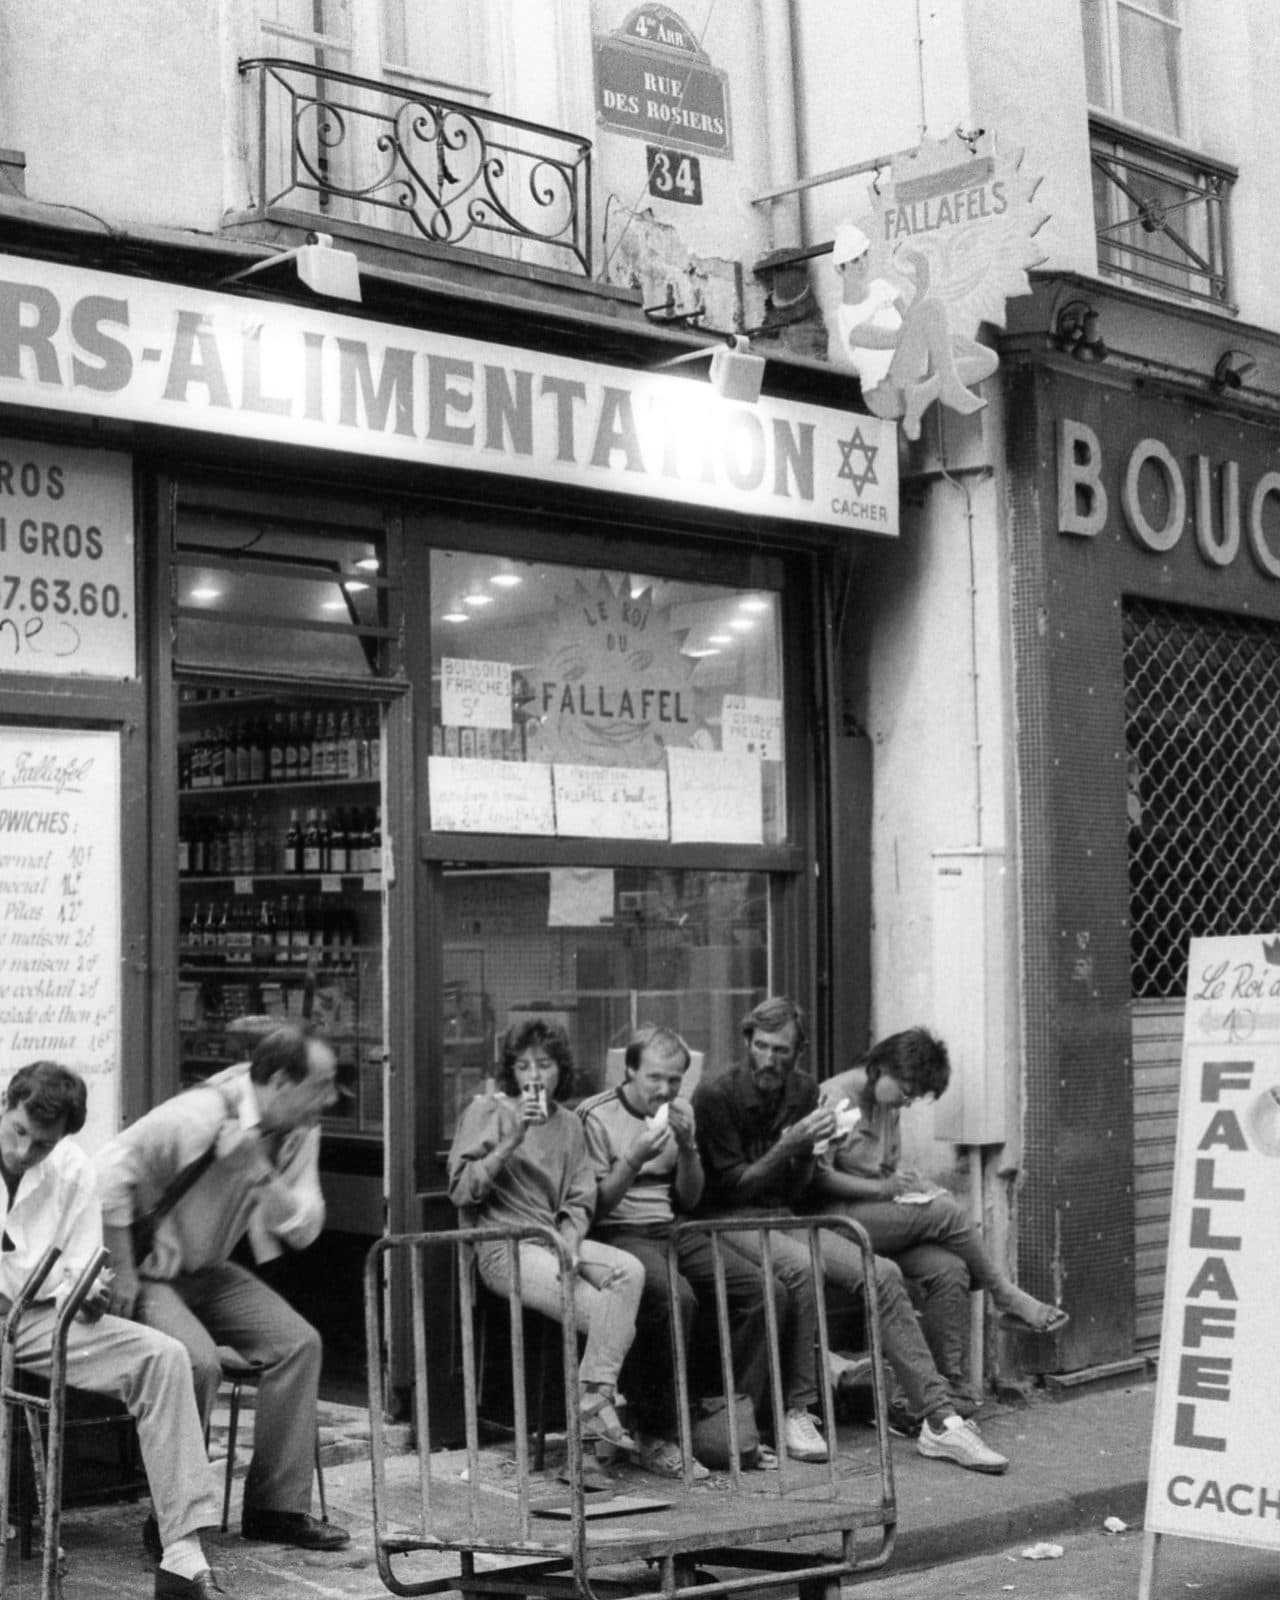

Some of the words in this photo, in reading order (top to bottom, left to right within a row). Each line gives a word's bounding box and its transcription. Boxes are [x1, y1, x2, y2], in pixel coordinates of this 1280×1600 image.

[644, 72, 683, 98] RUE
[603, 89, 640, 114] DES
[647, 100, 724, 135] ROSIERS
[655, 153, 695, 197] 34
[884, 181, 1008, 240] FALLAFELS
[831, 497, 888, 523] CACHER
[19, 518, 104, 561] GROS
[622, 601, 650, 632] ROI
[607, 633, 628, 653] DU
[542, 682, 689, 724] FALLAFEL
[12, 752, 95, 795] Fallafel
[1192, 960, 1230, 1000] Le
[1231, 963, 1270, 1000] Roi
[1174, 1061, 1255, 1453] FALLAFEL
